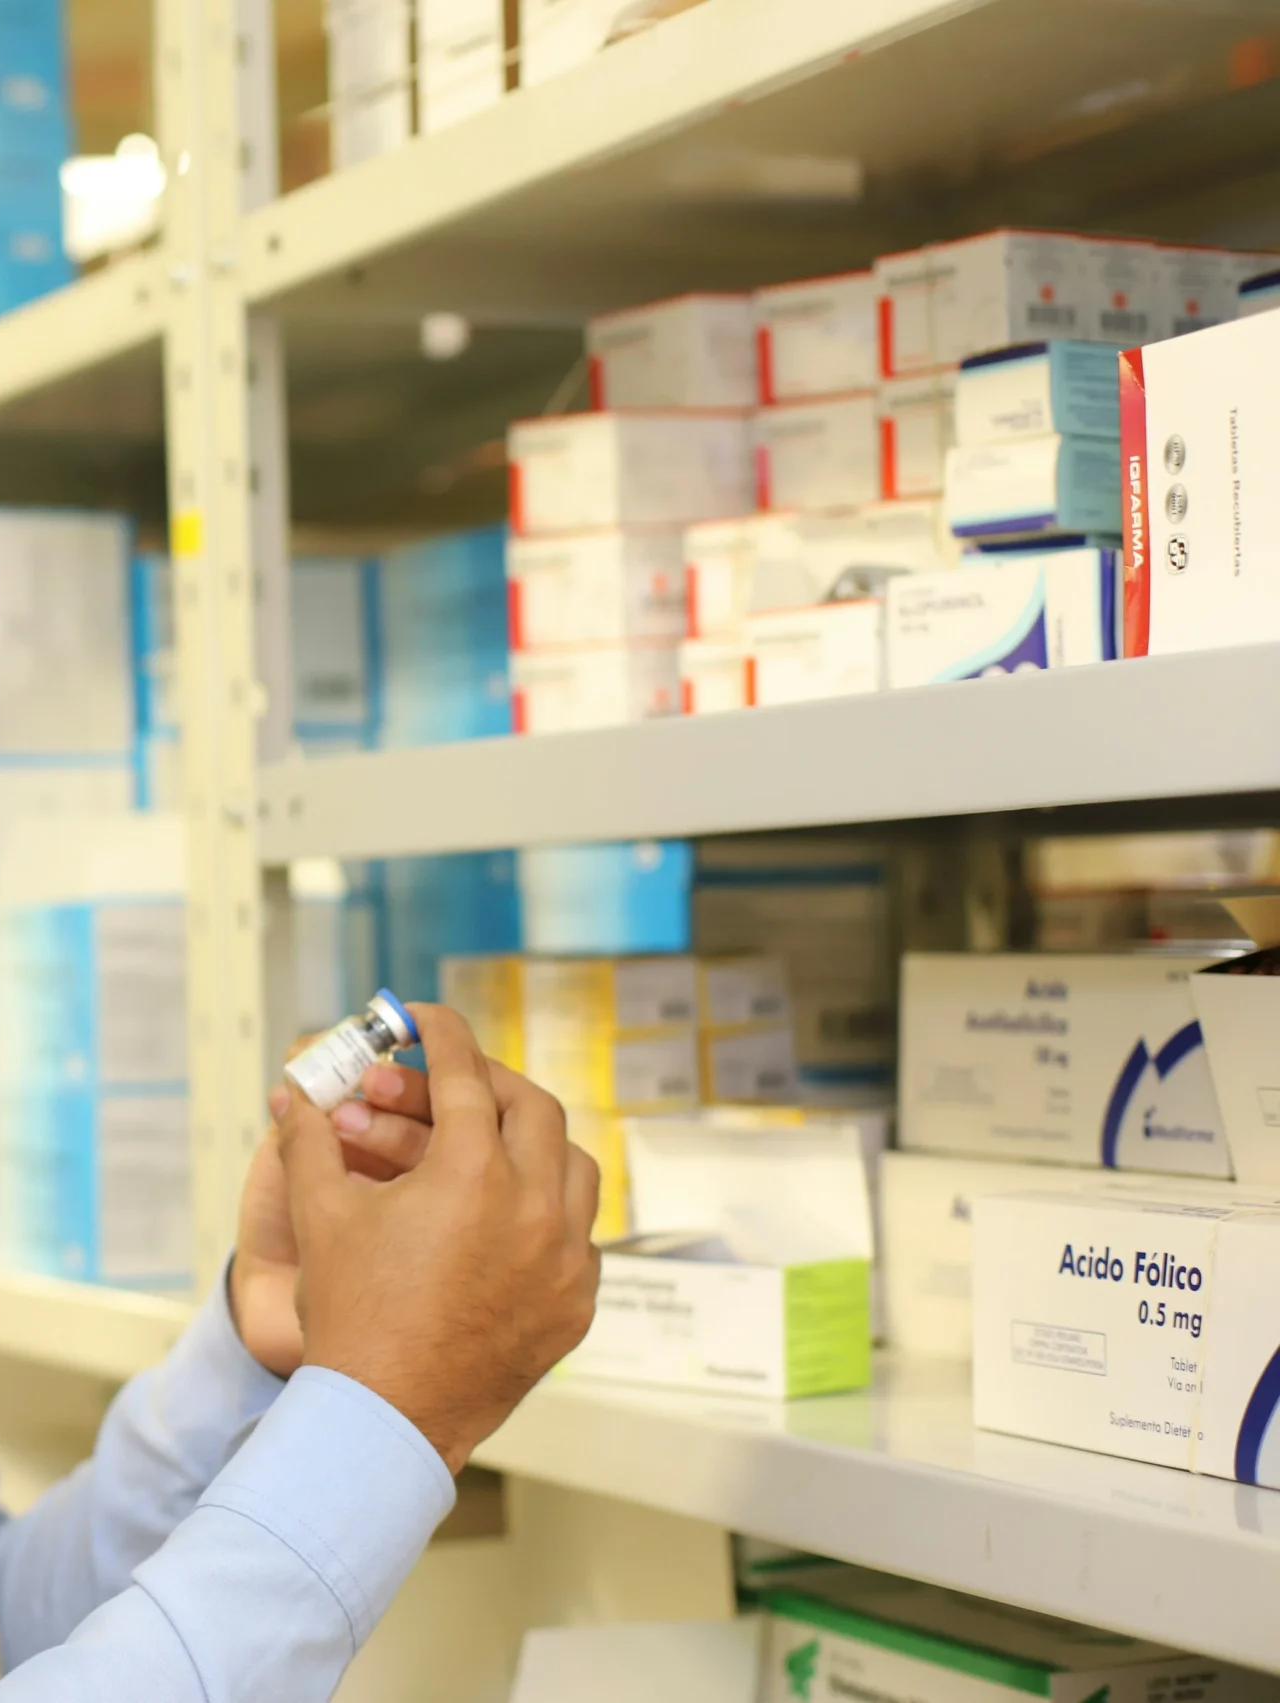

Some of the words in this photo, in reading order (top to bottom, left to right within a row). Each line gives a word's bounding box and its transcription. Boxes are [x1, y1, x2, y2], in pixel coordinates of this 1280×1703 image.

[1229, 407, 1239, 475] Tabletas
[1058, 1243, 1124, 1282] Acido
[1133, 1251, 1203, 1292] Fólico
[1138, 1299, 1167, 1327] 0.5
[1173, 1309, 1203, 1339] mg
[1170, 1356, 1198, 1374] Tablet
[1167, 1374, 1182, 1392] Via
[1164, 1420, 1204, 1442] Dietéto
